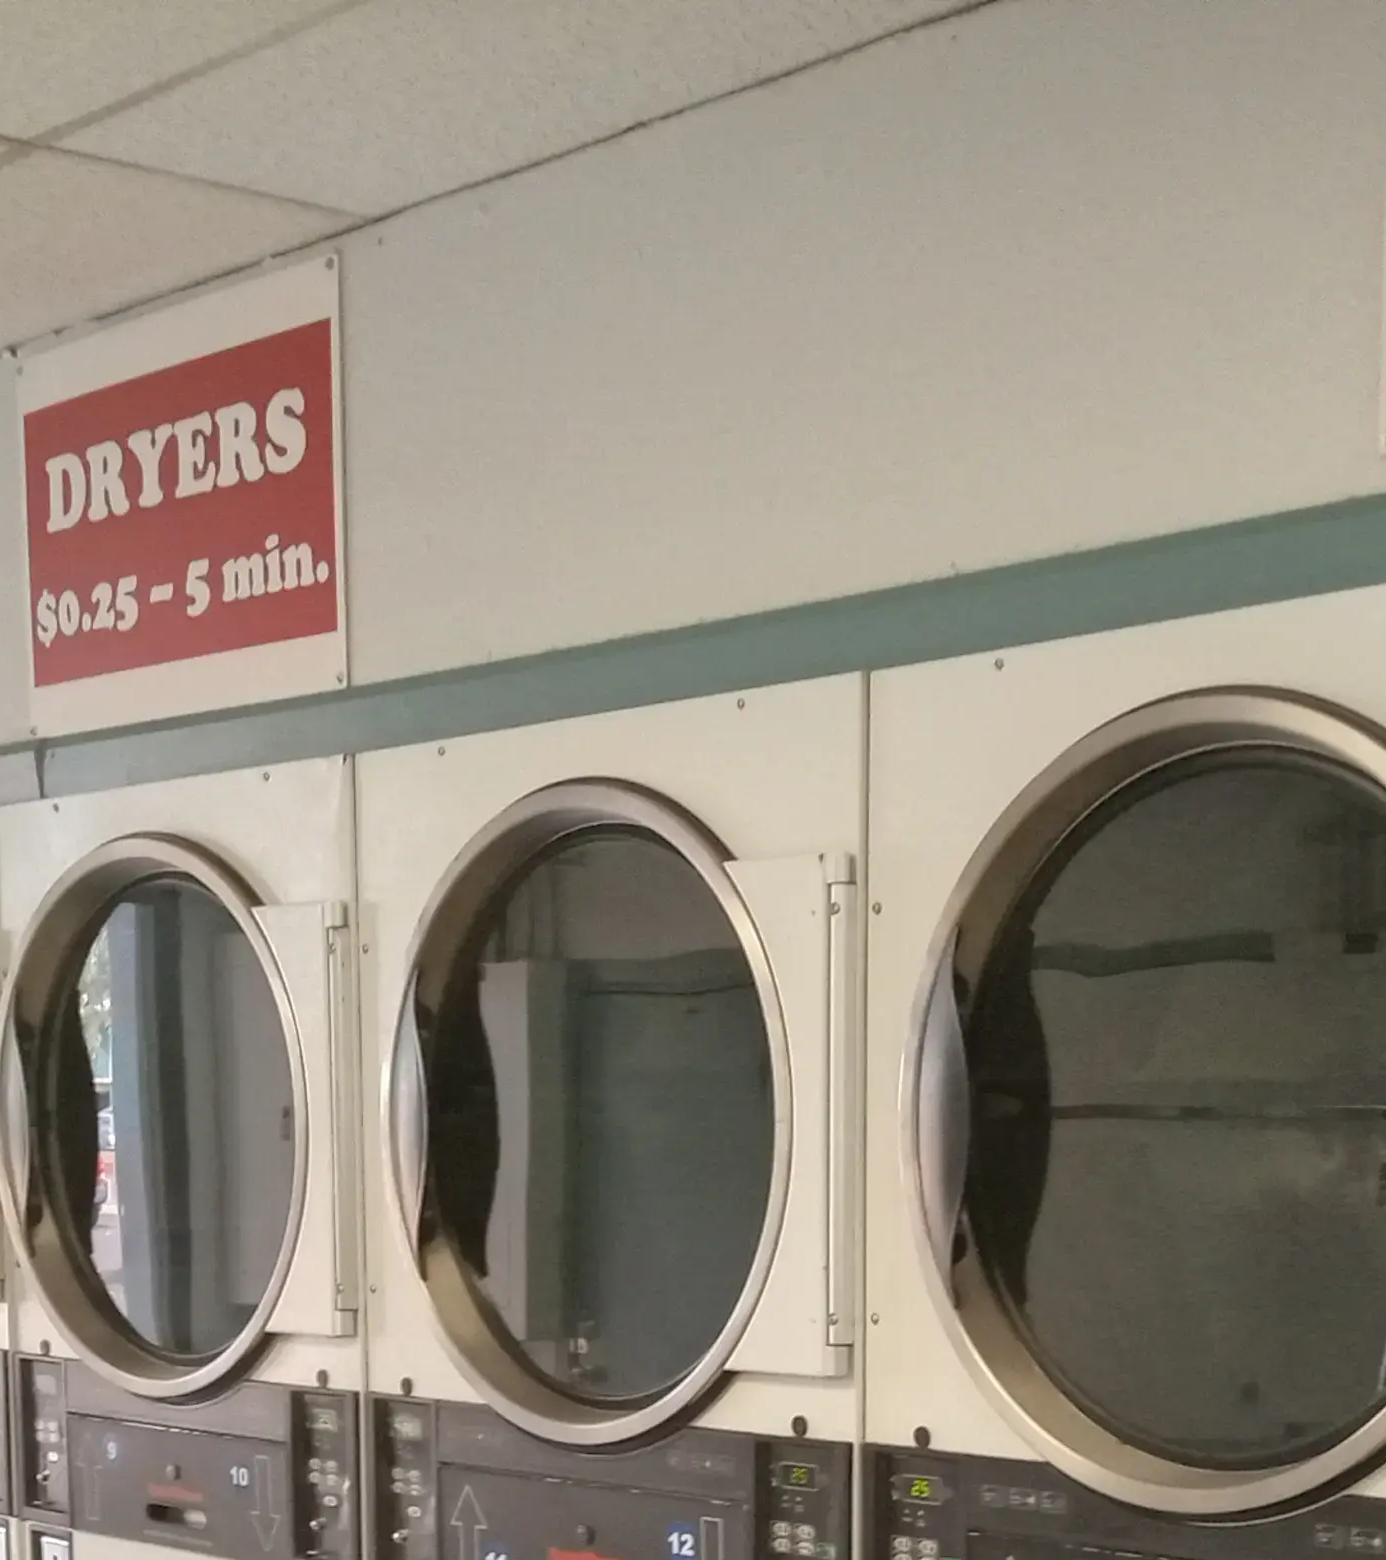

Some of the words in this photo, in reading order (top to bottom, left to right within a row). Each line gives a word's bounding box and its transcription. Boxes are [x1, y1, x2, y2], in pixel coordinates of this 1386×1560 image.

[45, 386, 306, 534] DRYERS
[36, 574, 140, 648] $0.25
[186, 558, 211, 618] 5
[221, 534, 330, 604] min.
[106, 1440, 117, 1460] 9
[229, 1465, 250, 1487] 10
[910, 1478, 931, 1498] 25
[667, 1531, 696, 1558] 12
